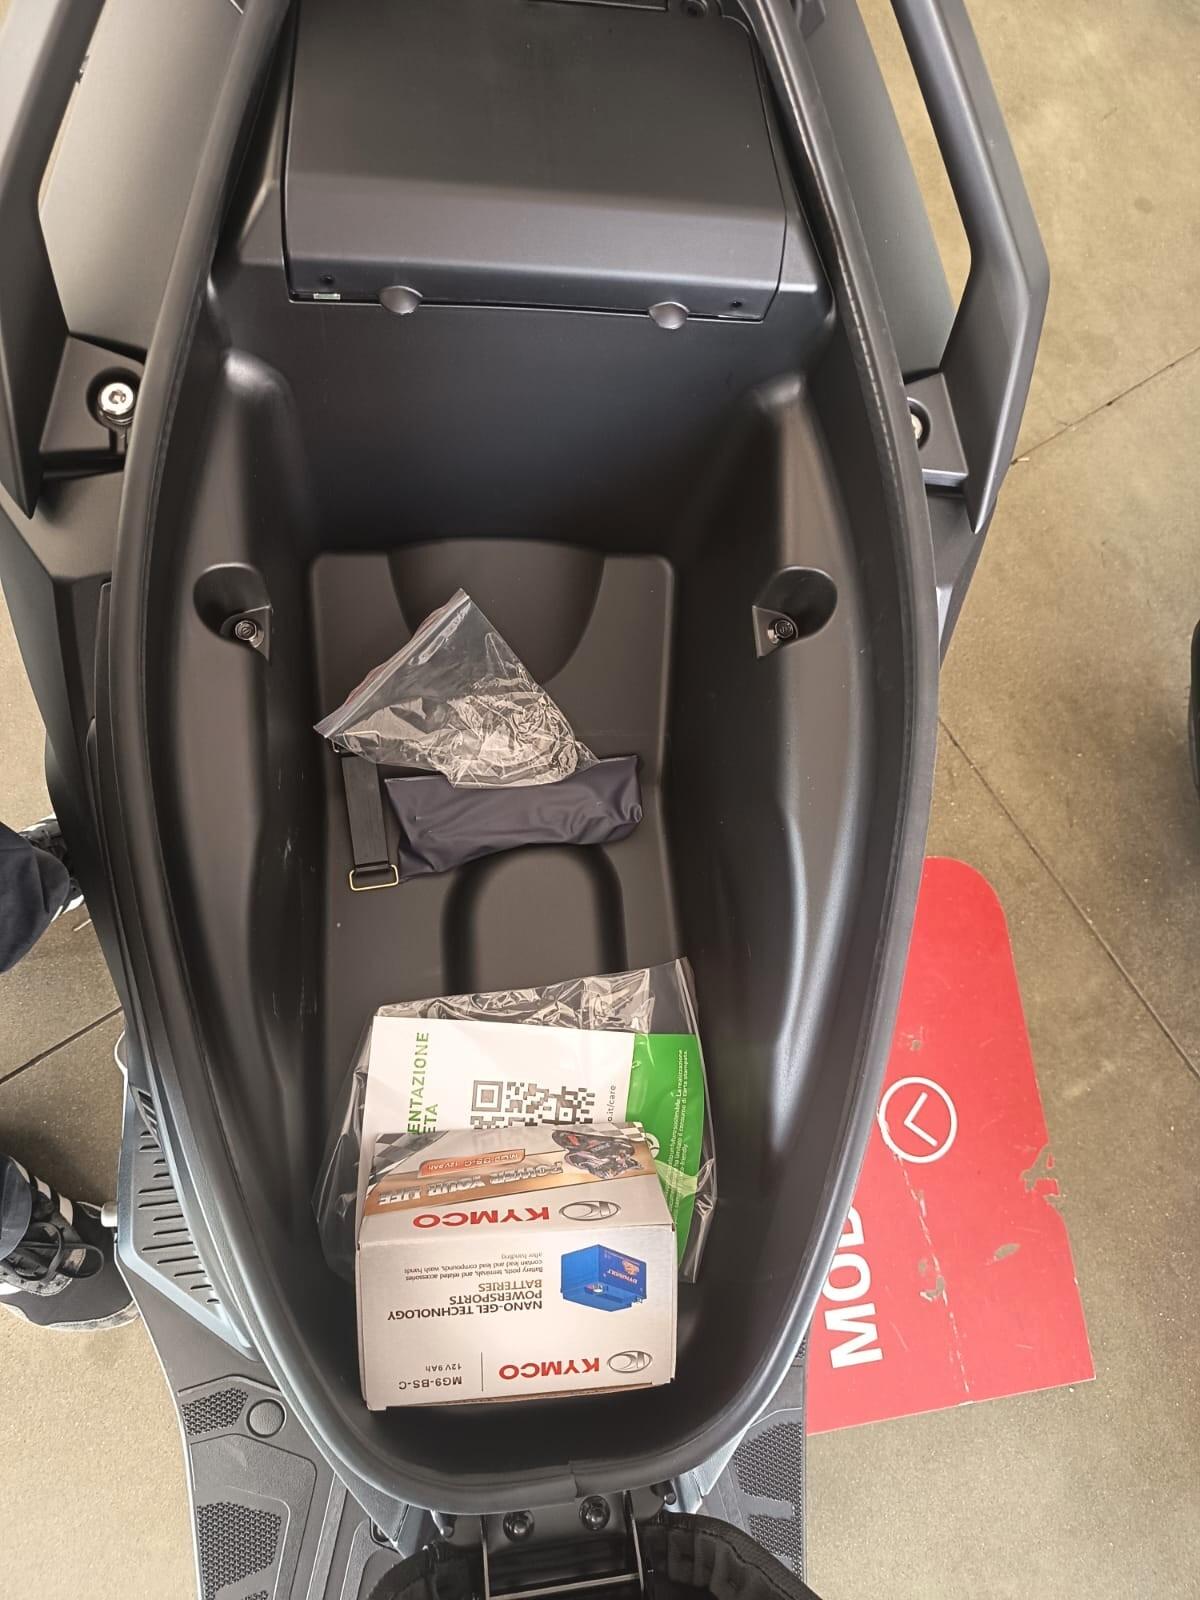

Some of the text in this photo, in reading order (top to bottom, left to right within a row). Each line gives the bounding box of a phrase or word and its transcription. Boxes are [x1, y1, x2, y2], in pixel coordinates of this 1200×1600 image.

[377, 1162, 563, 1206] POWER YOUR LIFE
[413, 1207, 549, 1228] KYMCO
[478, 1279, 542, 1292] BATTERIES
[449, 1290, 542, 1305] POWERSPORTS
[387, 1300, 542, 1320] NANO-GEL TECHNOLOGY
[498, 1357, 600, 1380] KYMCO
[398, 1376, 462, 1390] MG9-BS-C
